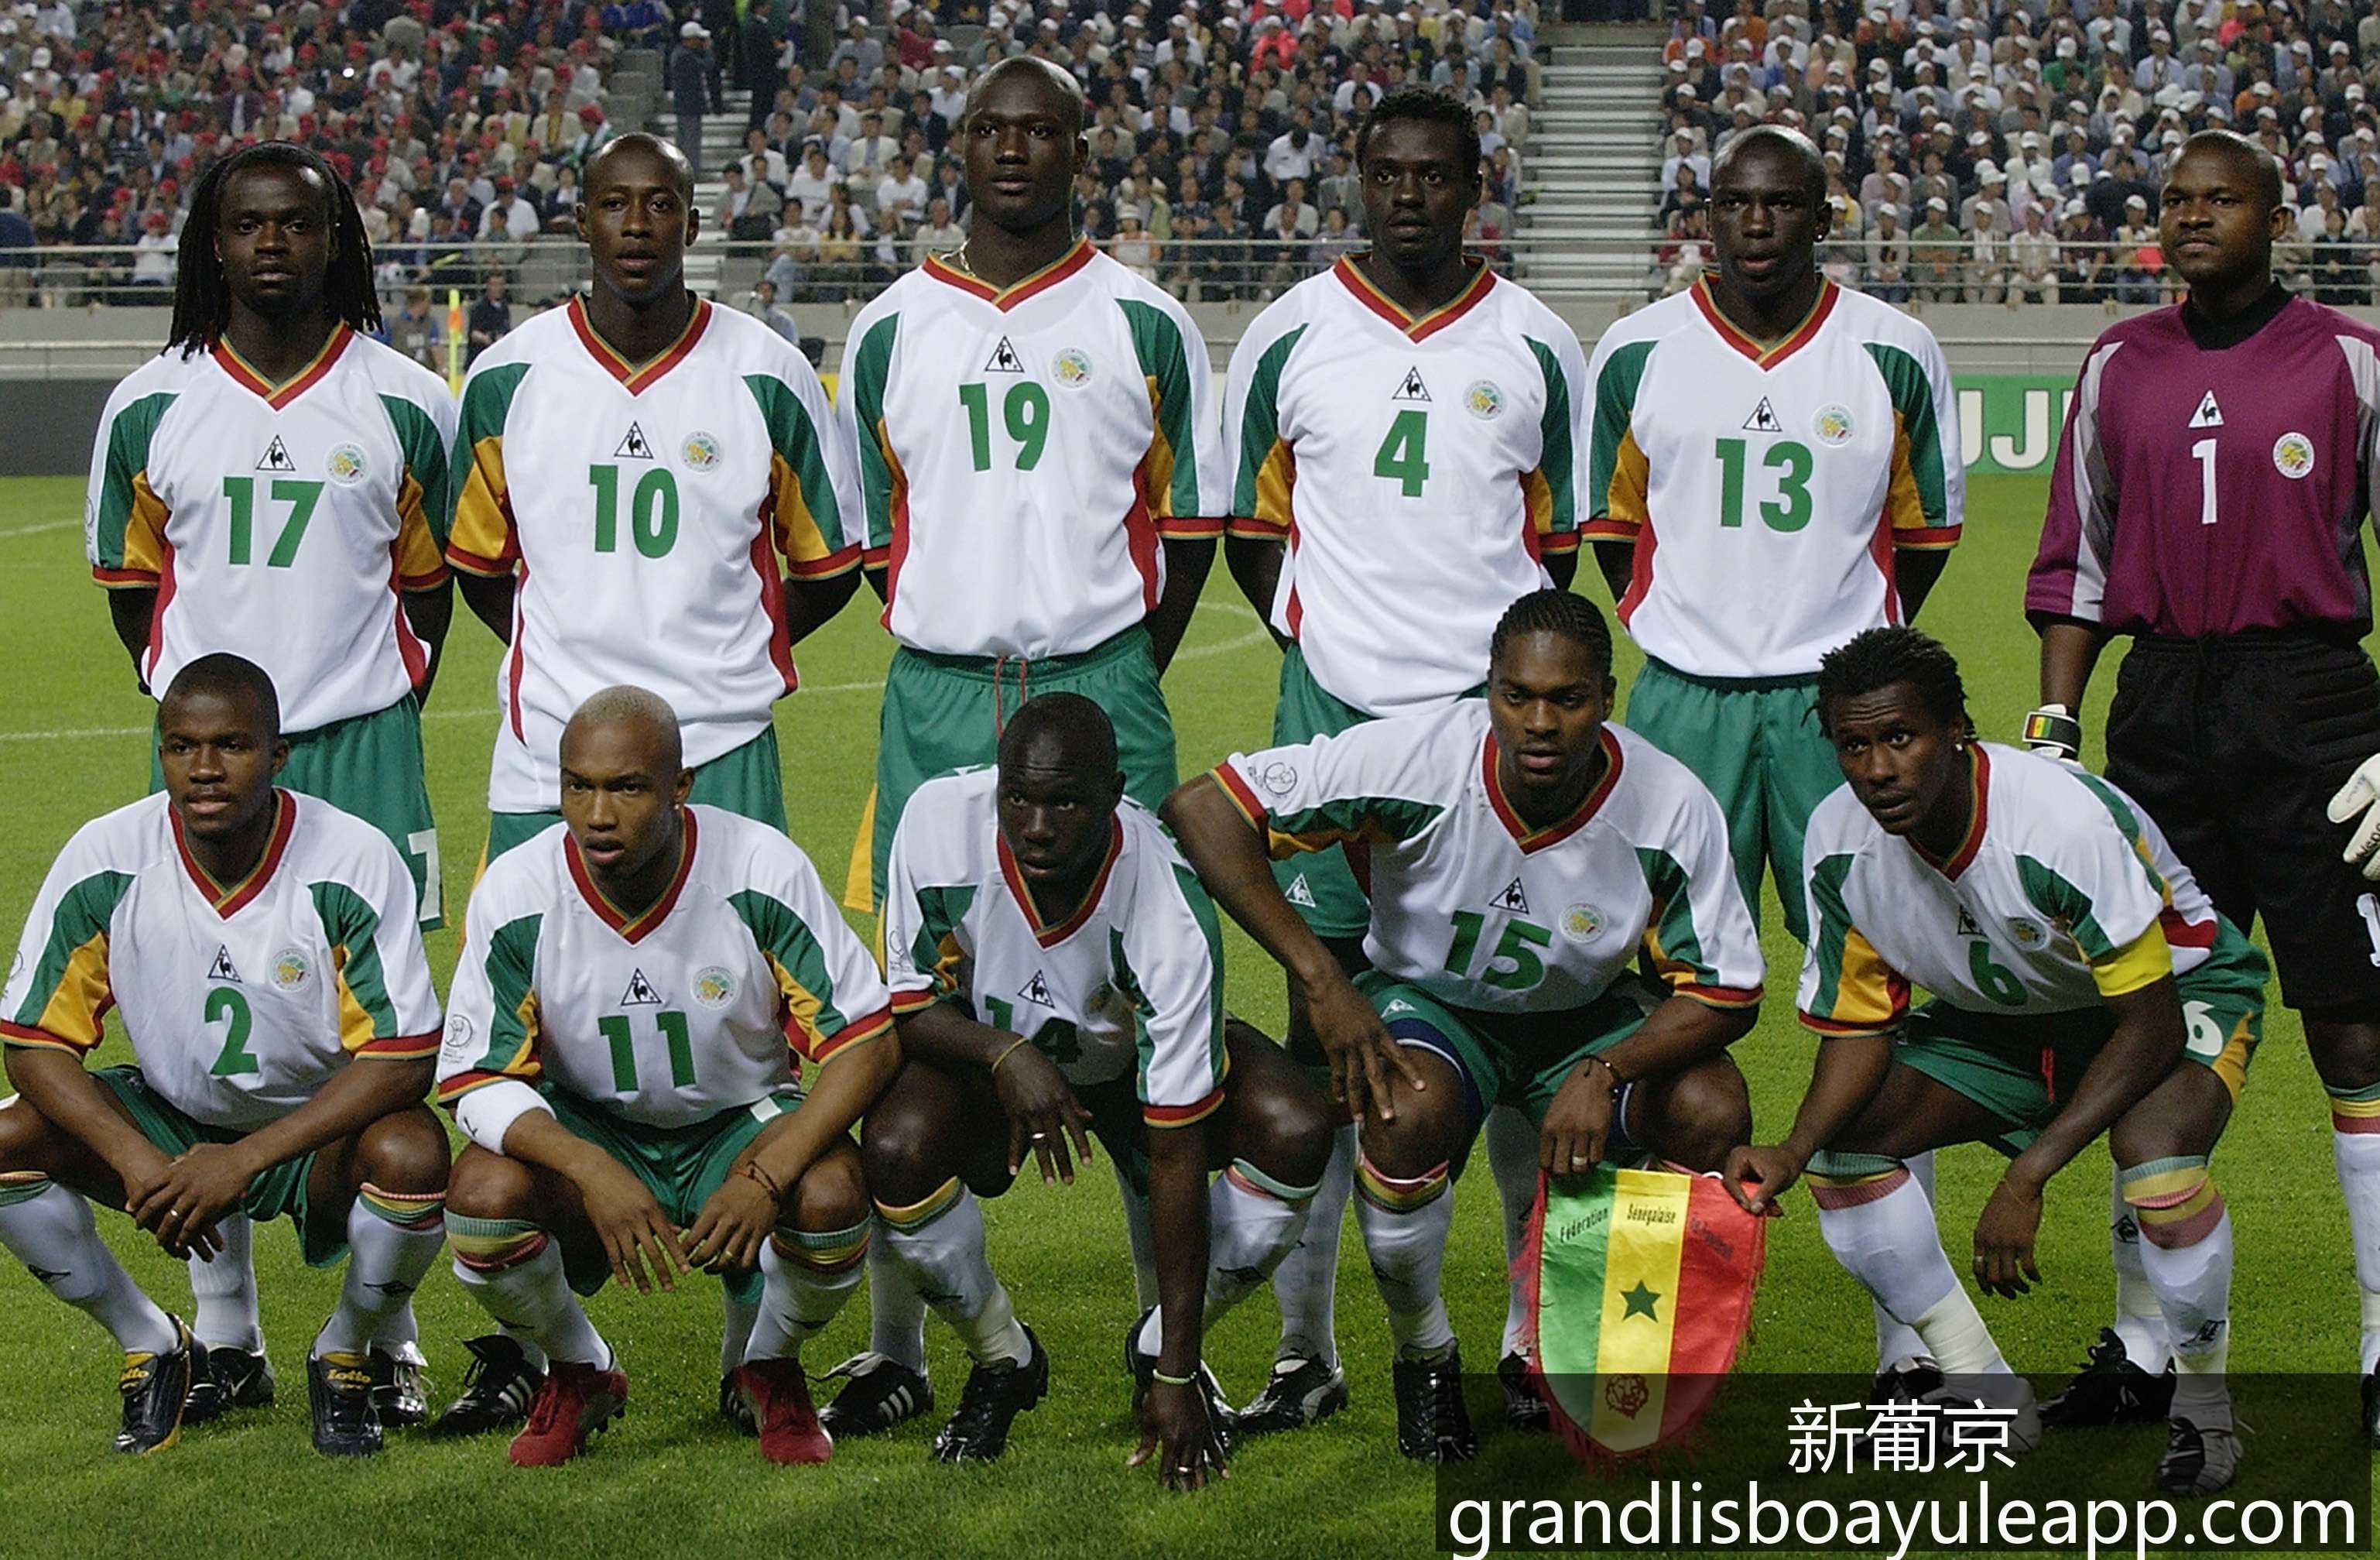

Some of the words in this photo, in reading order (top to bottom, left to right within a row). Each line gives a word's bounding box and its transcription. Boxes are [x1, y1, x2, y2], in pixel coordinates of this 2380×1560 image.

[959, 382, 1050, 471] 19
[1375, 410, 1430, 497] 4
[223, 476, 324, 567] 17
[590, 465, 680, 559] 10
[1716, 438, 1813, 532] 13
[2192, 437, 2217, 525] 1
[1444, 910, 1552, 991] 15
[1968, 941, 2029, 1007] 6
[204, 986, 259, 1076] 2
[598, 1011, 697, 1092] 11
[2183, 1000, 2223, 1057] 6
